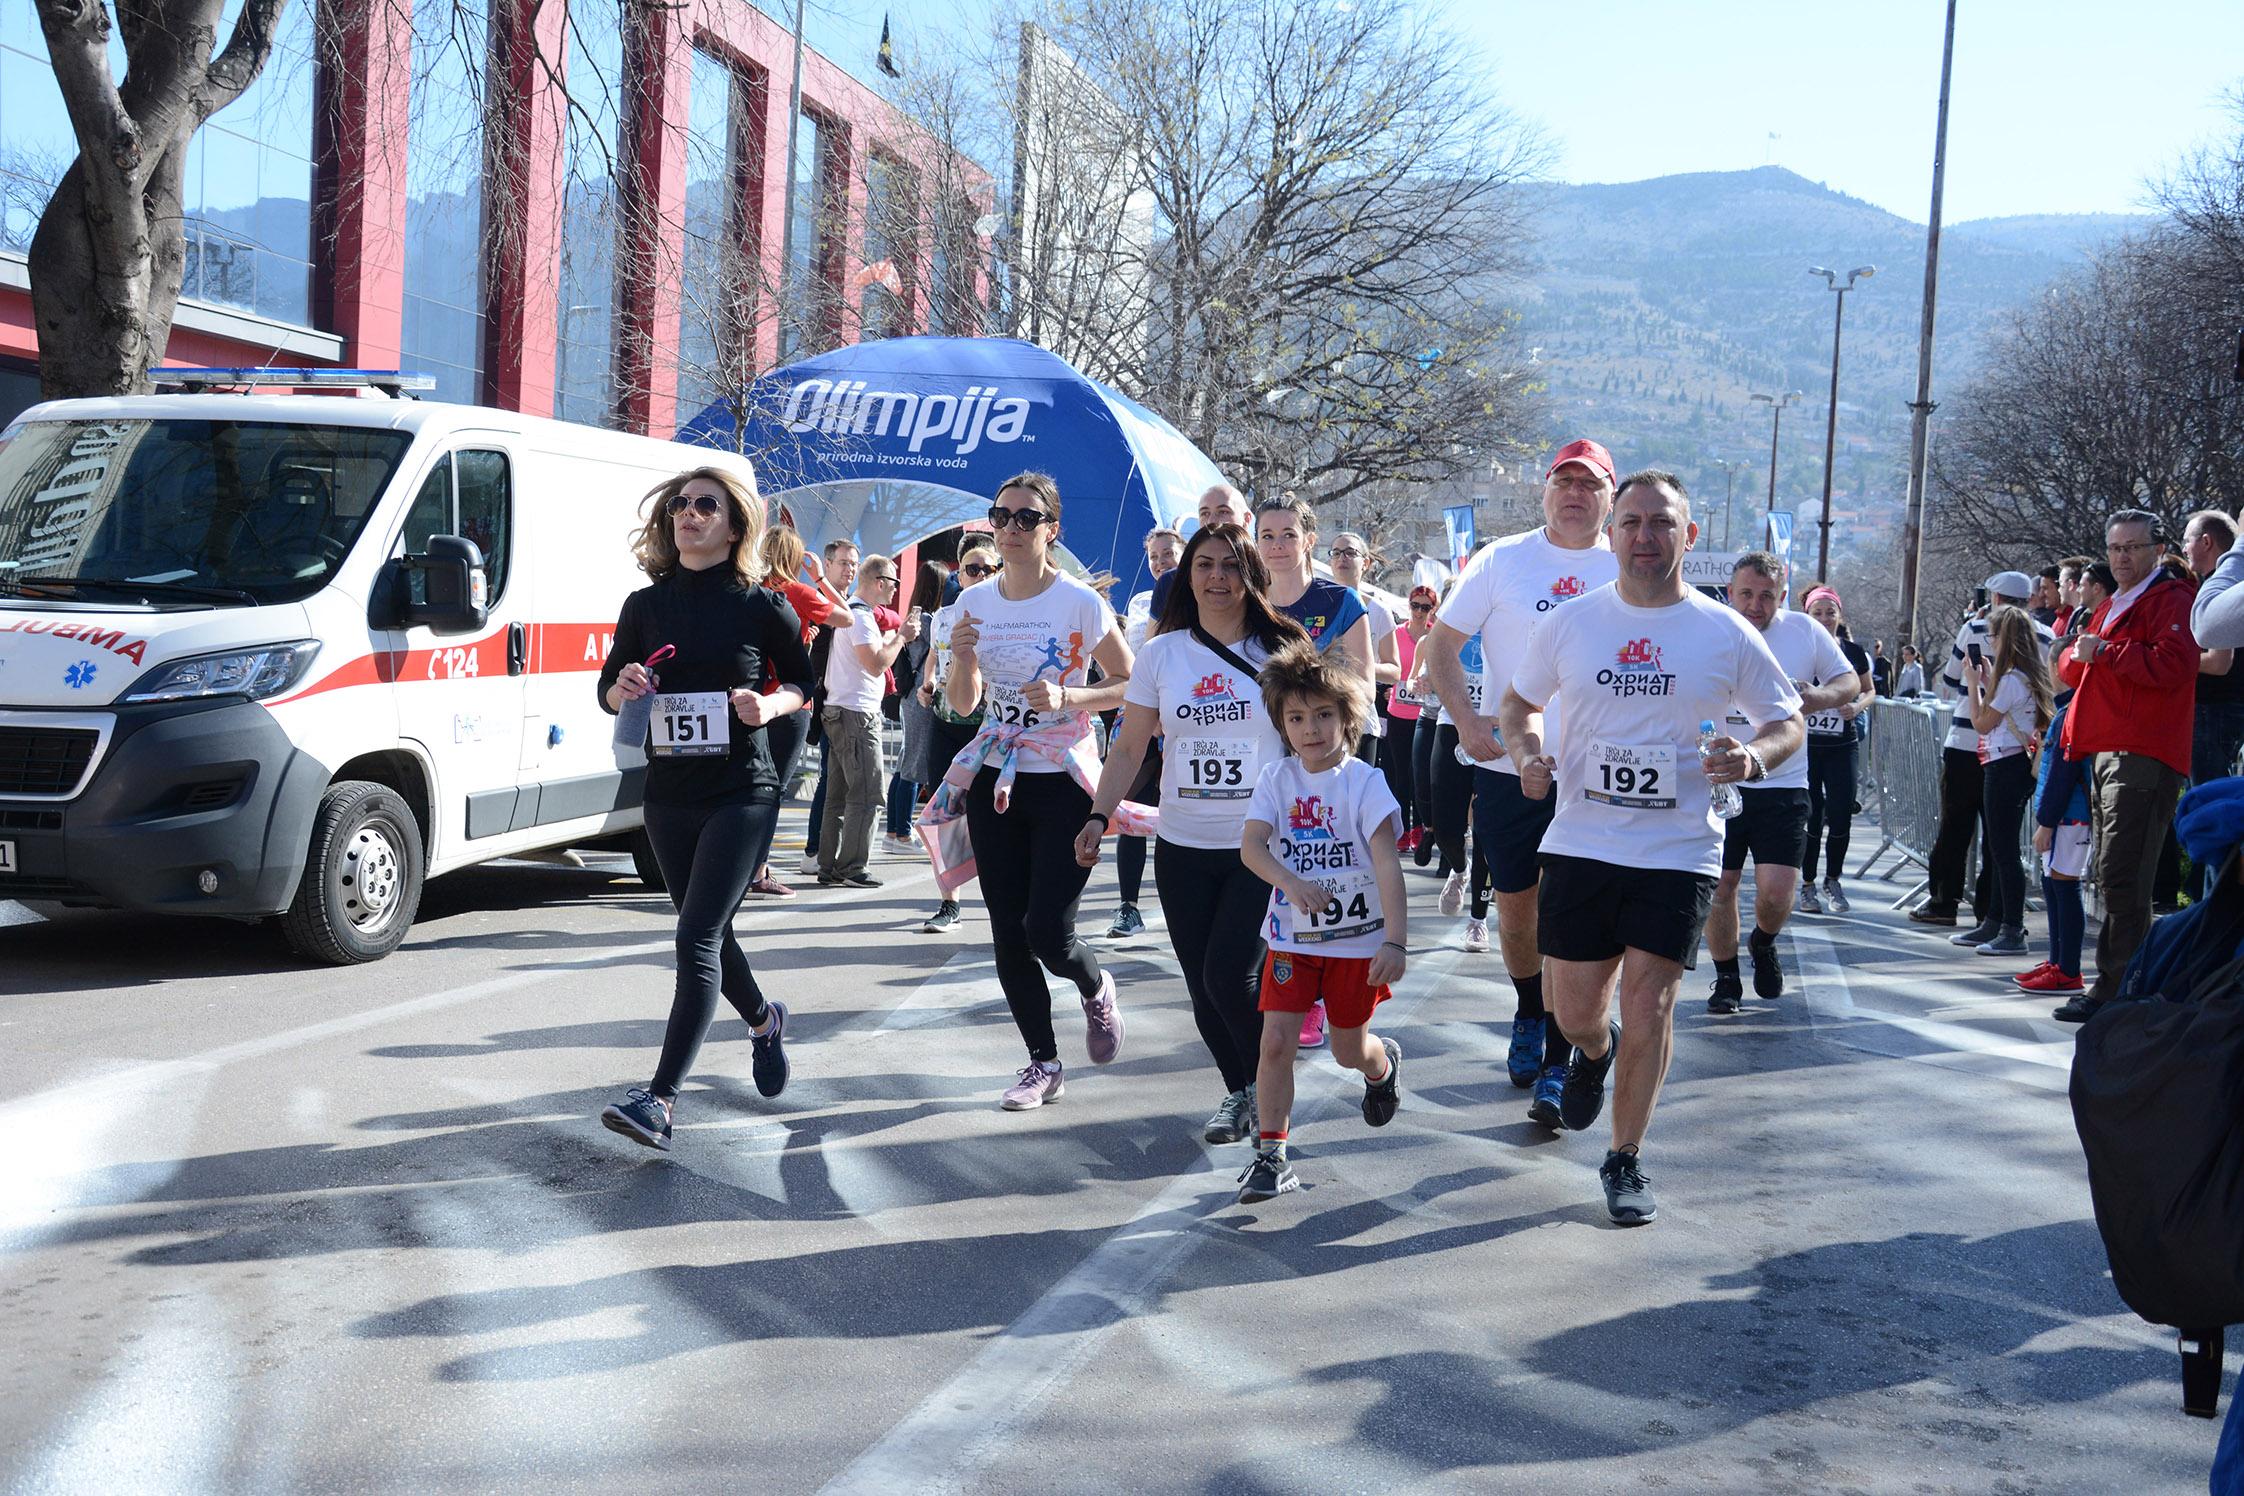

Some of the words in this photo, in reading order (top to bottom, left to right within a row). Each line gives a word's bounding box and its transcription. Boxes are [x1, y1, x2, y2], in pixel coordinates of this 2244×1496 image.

[781, 379, 1030, 455] Olimpija
[816, 450, 873, 464] prirodna
[877, 452, 932, 467] izvorska
[935, 457, 968, 469] voda
[991, 621, 1051, 630] HALFMARATHON
[443, 647, 479, 679] 124
[679, 697, 688, 705] ZA
[664, 714, 709, 742] 151
[1808, 715, 1840, 730] 047
[1209, 741, 1219, 749] ZA
[1189, 759, 1243, 786] 193
[1600, 764, 1659, 794] 192
[1327, 877, 1338, 887] ZA
[1309, 892, 1369, 928] 194
